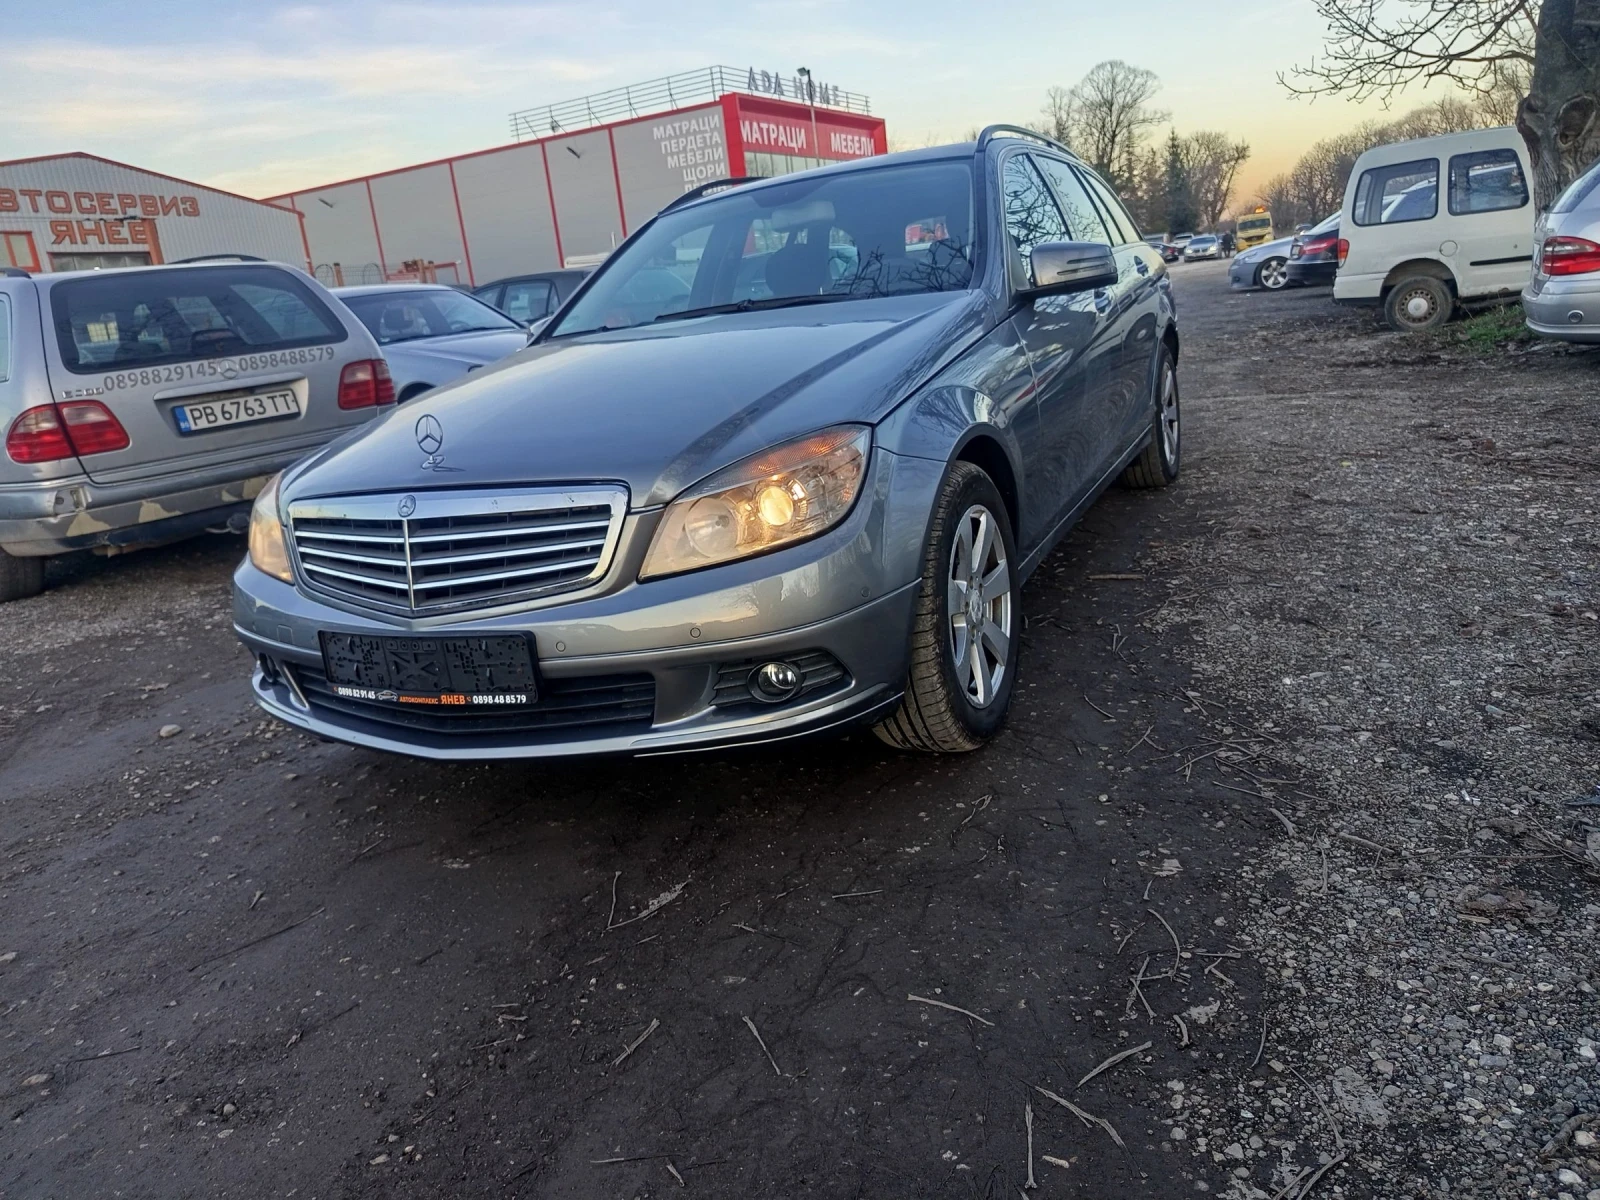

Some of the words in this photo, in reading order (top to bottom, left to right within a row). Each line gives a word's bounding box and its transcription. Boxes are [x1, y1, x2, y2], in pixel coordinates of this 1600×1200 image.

[748, 66, 784, 96] ADA
[793, 76, 840, 106] HOME
[653, 114, 719, 140] МАТРАЦИ
[661, 131, 721, 154] ПЕРДЕТА
[830, 132, 875, 156] МЕБЕЛИ
[667, 147, 723, 169] МЕБЕЛИ
[683, 162, 726, 182] ЩОРИ
[0, 187, 200, 217] ВТОСЕРВИЗ
[50, 219, 149, 245] ЯНЕВ
[104, 361, 217, 391] 0898829145
[239, 346, 335, 373] 0898488579
[221, 398, 266, 421] 6763
[267, 393, 291, 412] TT
[440, 695, 466, 705] ЯНЕВ
[472, 695, 493, 704] 0898
